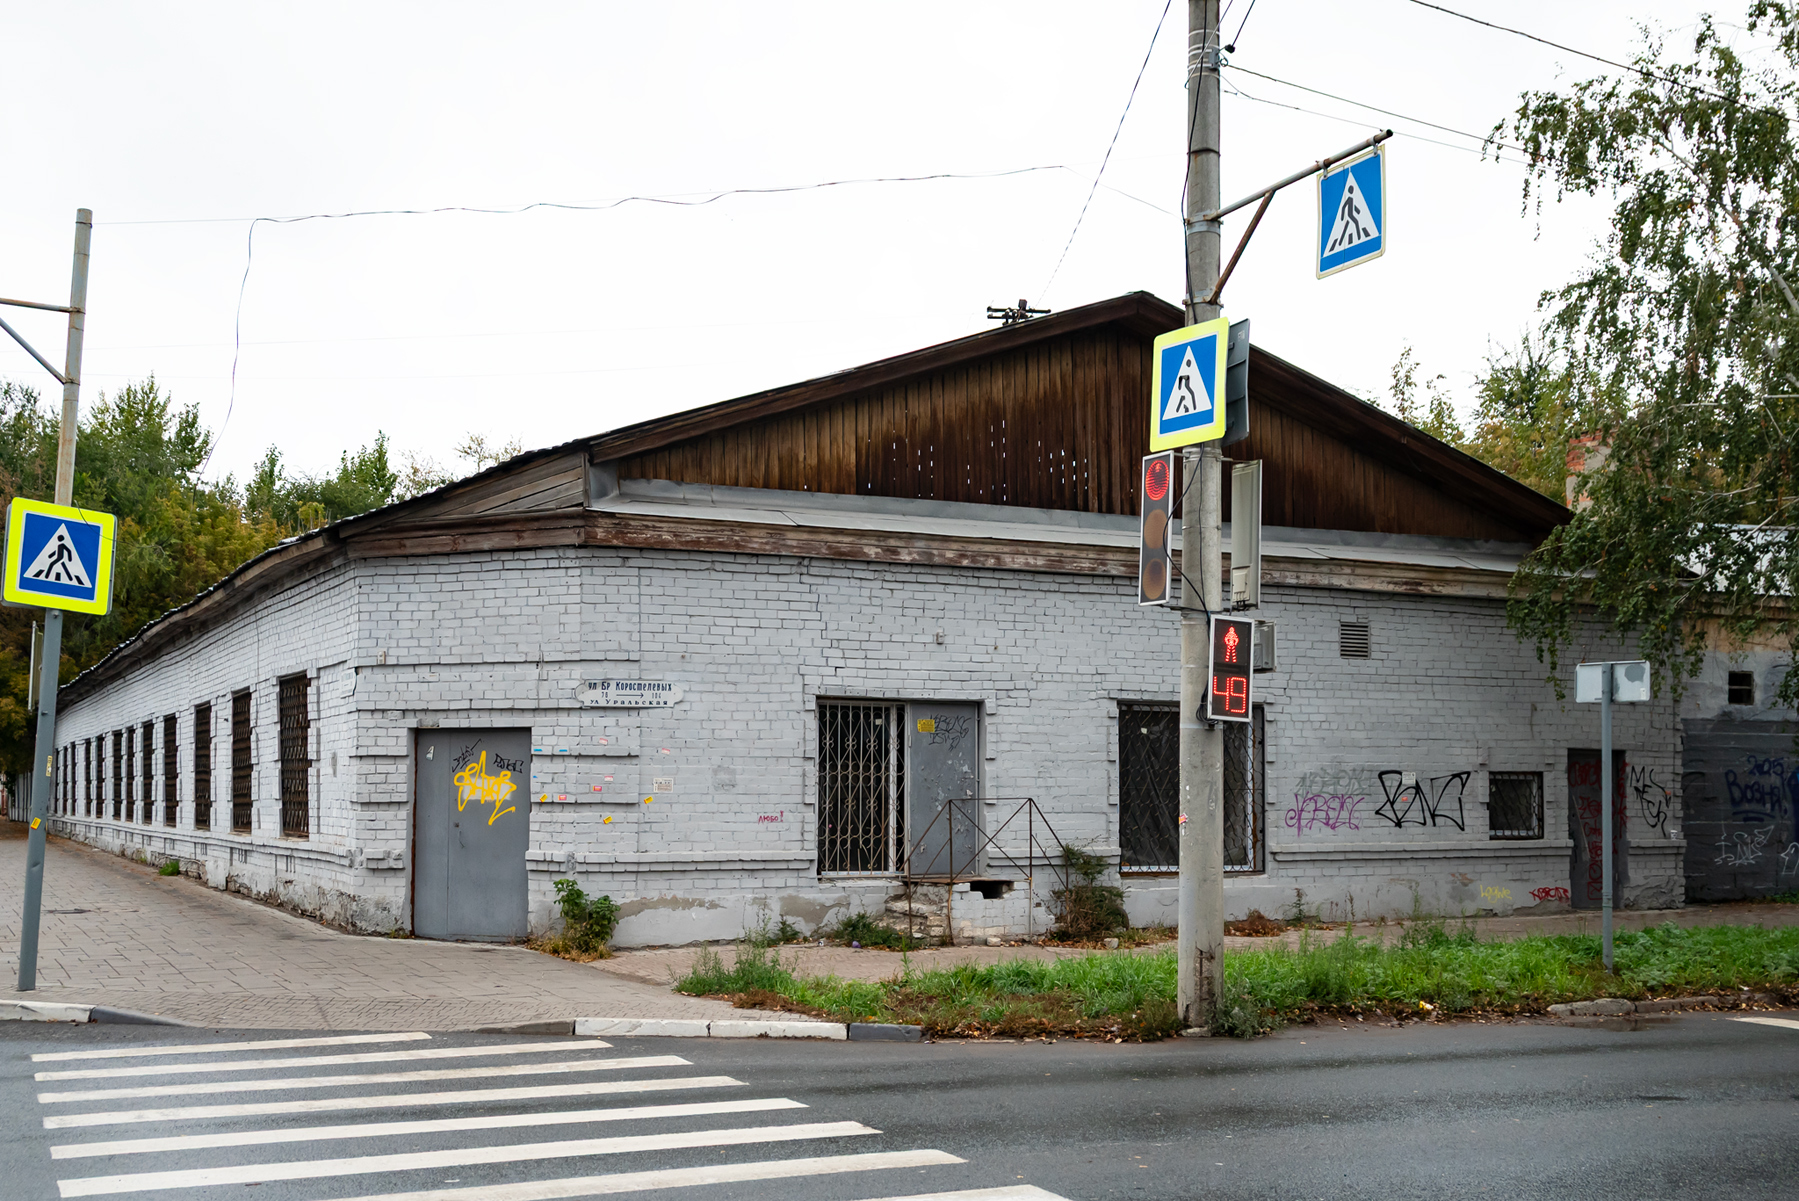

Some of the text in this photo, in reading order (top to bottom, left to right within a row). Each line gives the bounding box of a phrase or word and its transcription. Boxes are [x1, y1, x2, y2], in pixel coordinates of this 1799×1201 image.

[588, 681, 672, 692] ул Бр Коростелевых
[1212, 675, 1247, 714] 49
